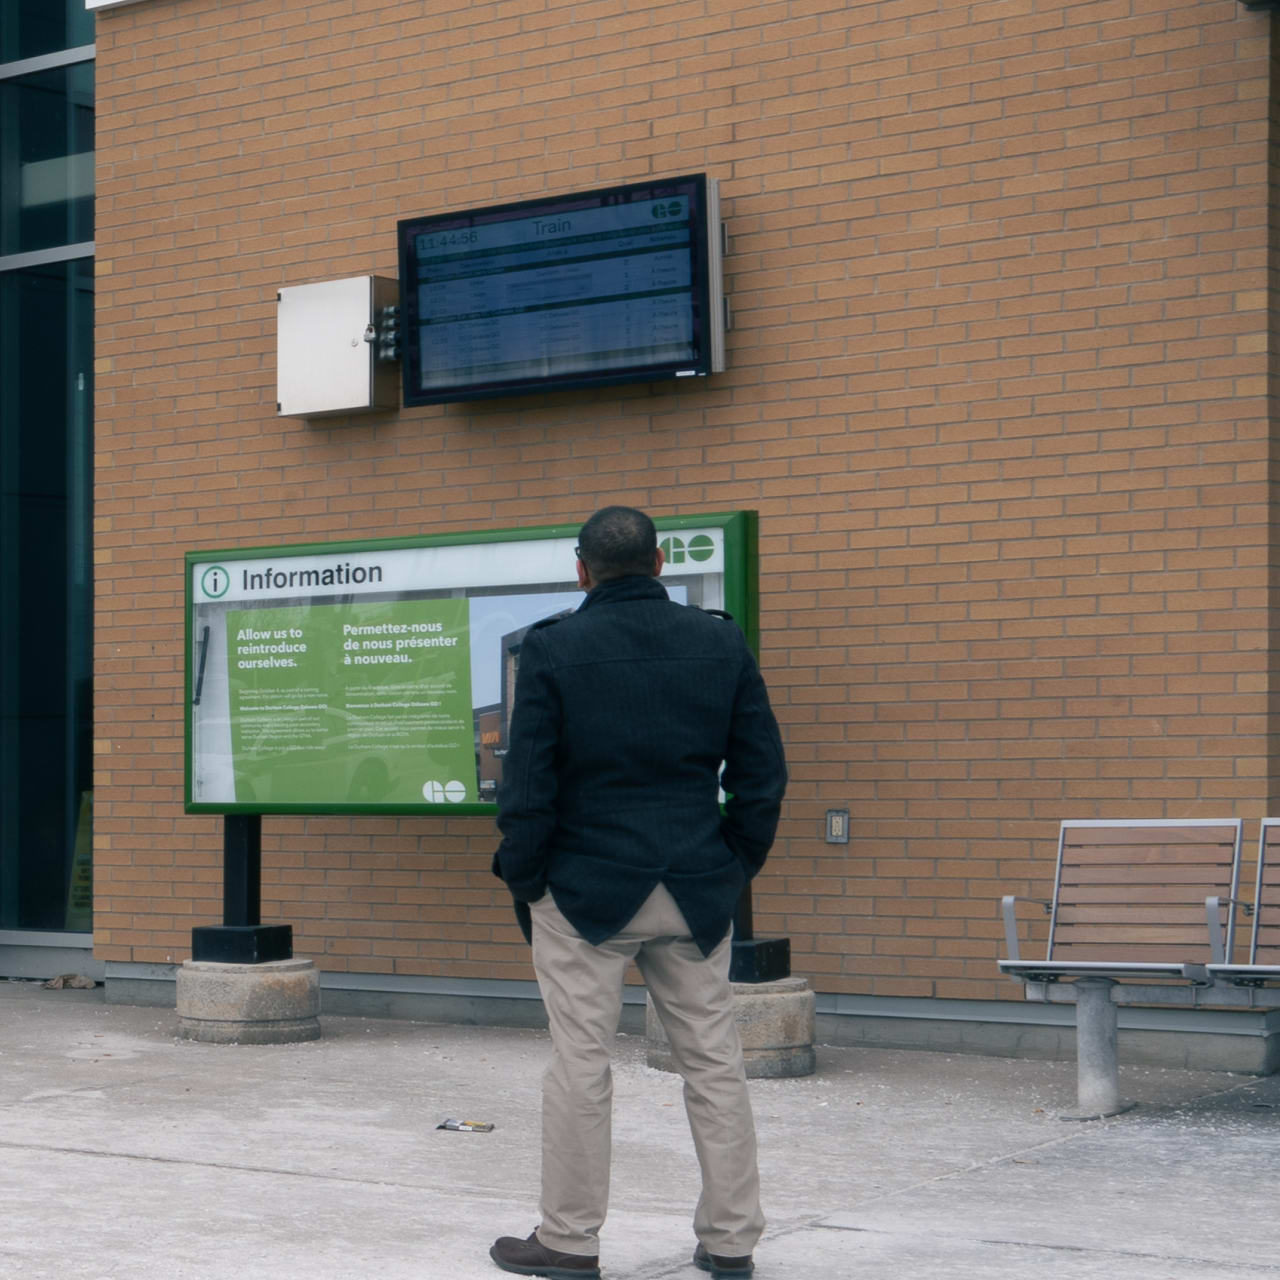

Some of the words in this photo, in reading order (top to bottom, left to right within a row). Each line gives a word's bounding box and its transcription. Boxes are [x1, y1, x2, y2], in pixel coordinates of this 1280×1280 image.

[533, 218, 572, 236] Train
[243, 563, 383, 591] Information
[237, 628, 272, 641] Allow
[274, 629, 287, 639] us
[289, 627, 303, 639] to
[343, 622, 443, 637] Permettez-nous
[237, 642, 307, 655] reintroduce
[344, 639, 360, 651] de
[362, 639, 393, 650] nous
[396, 636, 458, 652] présenter
[238, 657, 298, 669] ourselves.
[343, 653, 352, 665] à
[354, 652, 413, 665] nouveau.
